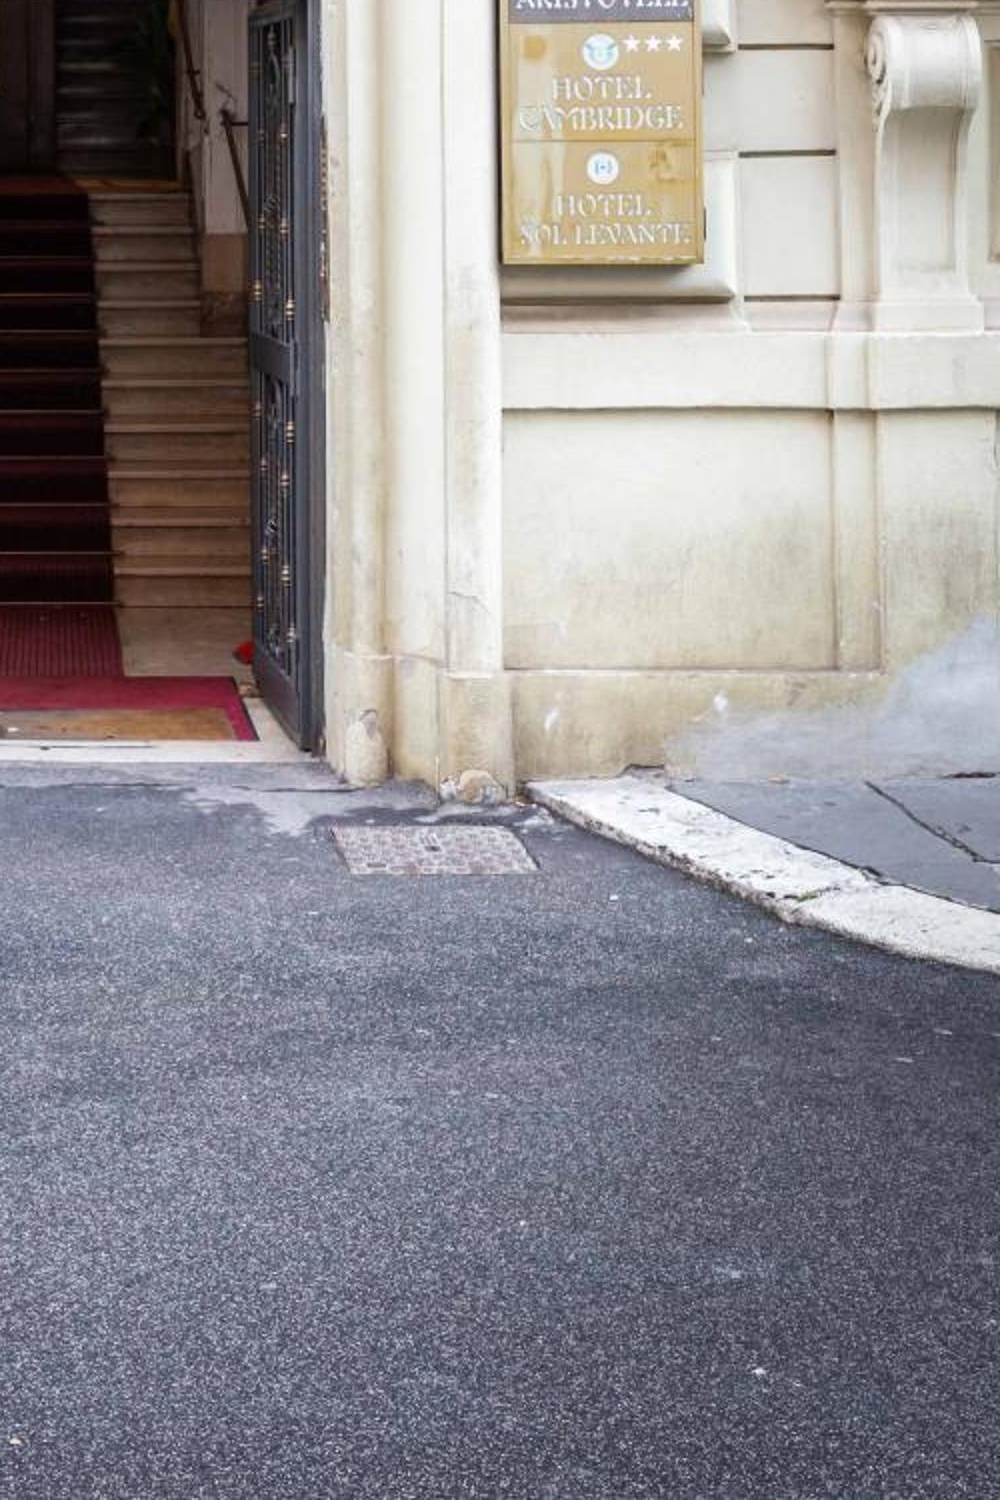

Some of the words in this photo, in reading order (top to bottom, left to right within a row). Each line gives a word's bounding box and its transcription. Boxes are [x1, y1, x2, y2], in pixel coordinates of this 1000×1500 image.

[551, 76, 651, 101] HOTEL
[518, 106, 684, 132] CAMBRIDGE
[554, 194, 651, 218] HOTEL
[520, 222, 567, 245] SOL
[574, 222, 690, 245] LEVANTE
